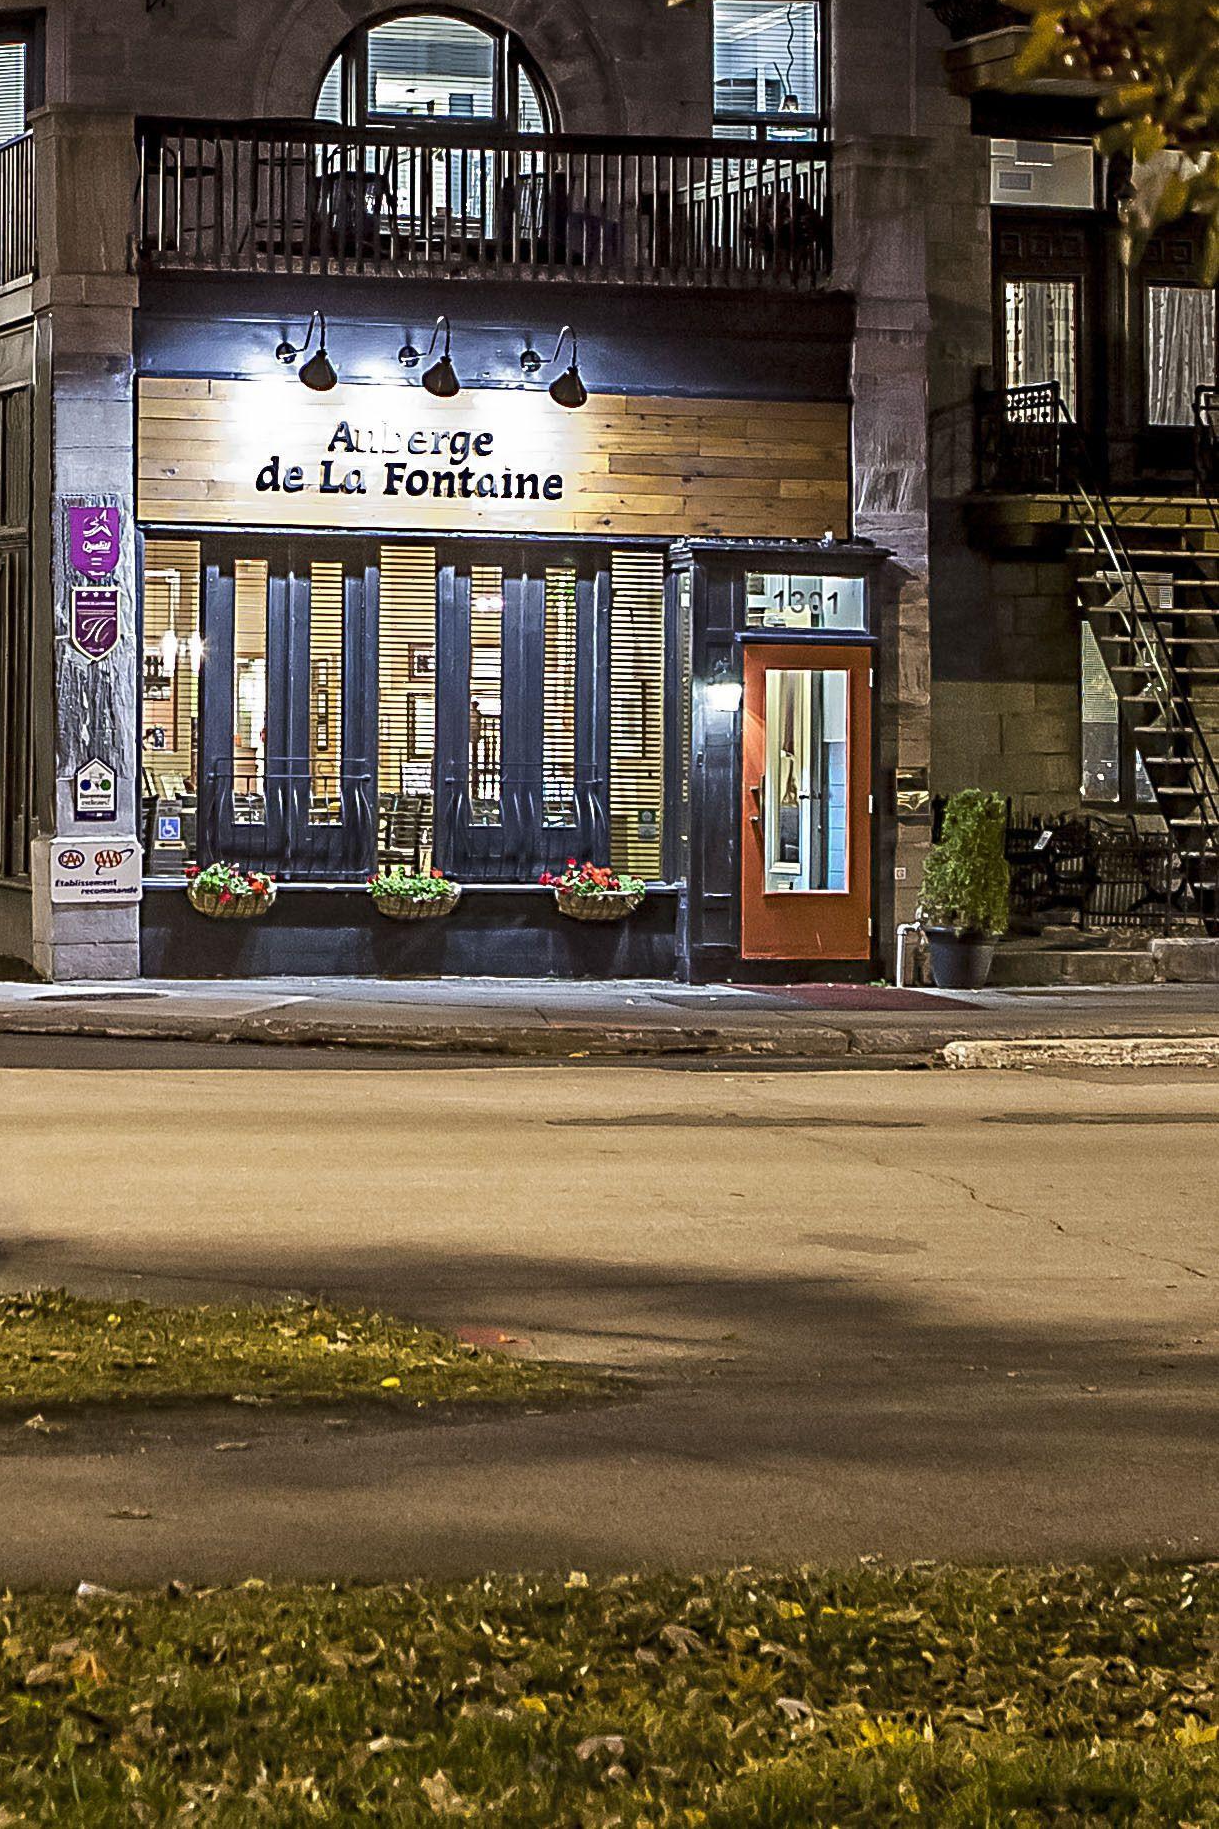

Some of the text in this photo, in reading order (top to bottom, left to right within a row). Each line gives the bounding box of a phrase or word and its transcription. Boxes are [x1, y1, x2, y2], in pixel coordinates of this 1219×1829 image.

[328, 420, 493, 465] Auberge
[255, 456, 563, 500] de La Fontaine
[774, 590, 838, 614] 1301
[61, 850, 119, 868] CAA AAA
